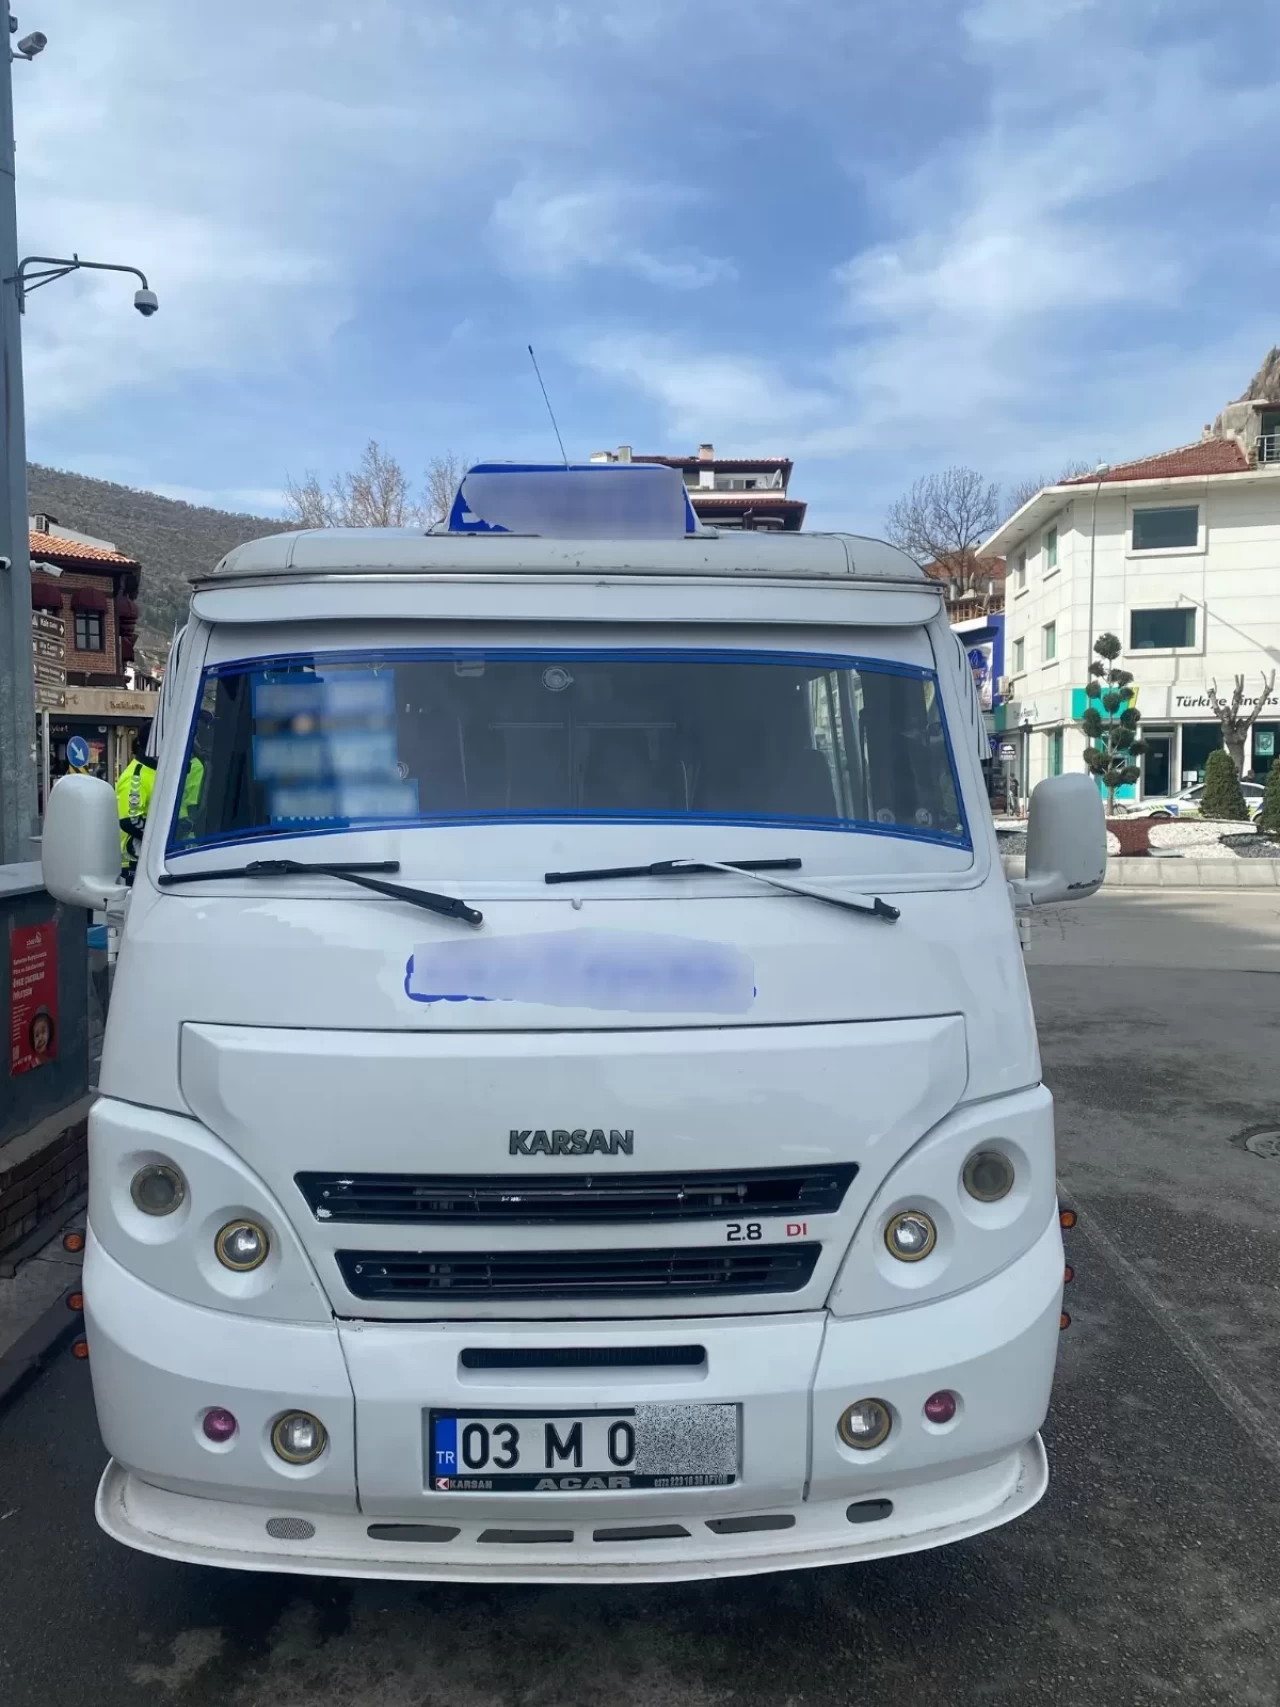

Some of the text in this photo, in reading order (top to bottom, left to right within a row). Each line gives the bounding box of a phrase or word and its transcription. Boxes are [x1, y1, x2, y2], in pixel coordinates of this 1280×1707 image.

[1231, 694, 1279, 706] inans
[509, 1130, 634, 1155] KARSAN
[726, 1223, 807, 1242] 2.8 DI
[462, 1422, 520, 1470] 03
[544, 1421, 583, 1468] M
[436, 1451, 455, 1464] TR
[450, 1480, 492, 1489] KARSAN
[534, 1476, 631, 1490] ACAR
